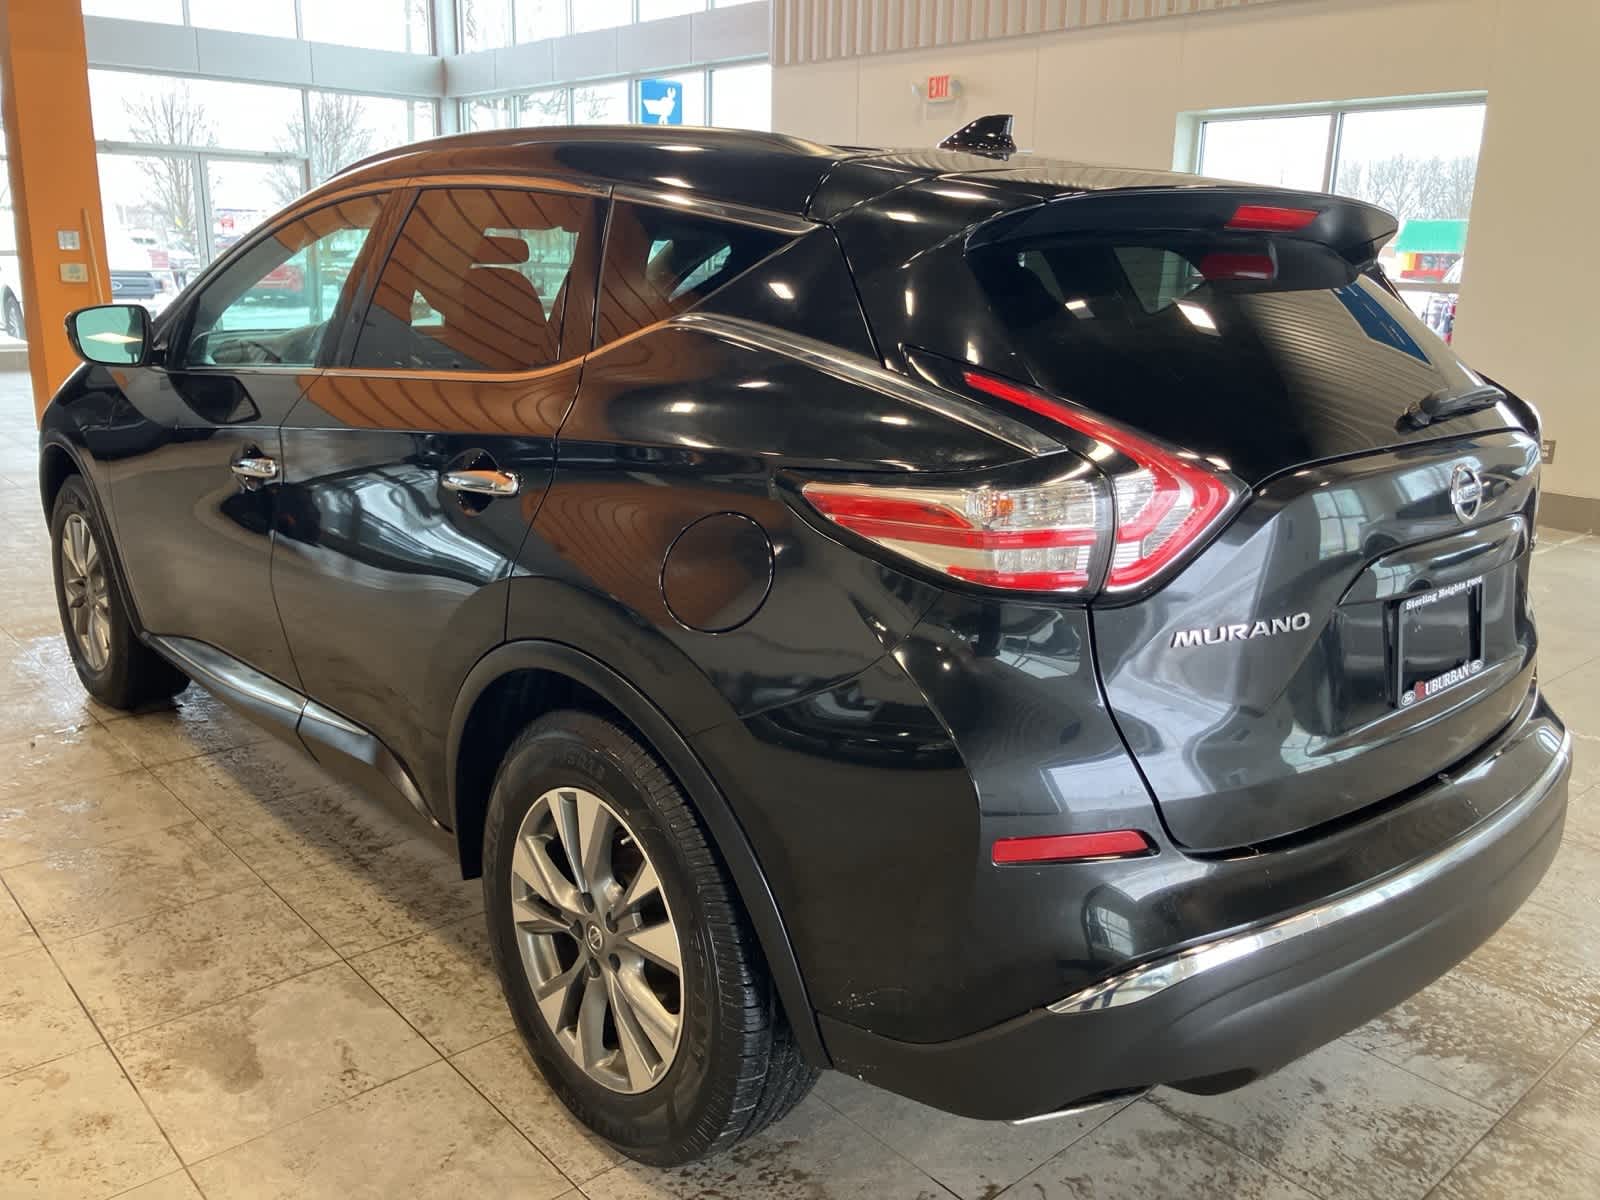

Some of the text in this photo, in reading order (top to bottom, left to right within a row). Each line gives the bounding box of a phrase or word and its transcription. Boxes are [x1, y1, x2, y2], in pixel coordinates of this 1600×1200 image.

[928, 75, 950, 99] EXIT
[1406, 592, 1438, 610] Sterling
[1438, 581, 1466, 599] Heights
[1172, 612, 1311, 648] MURANO
